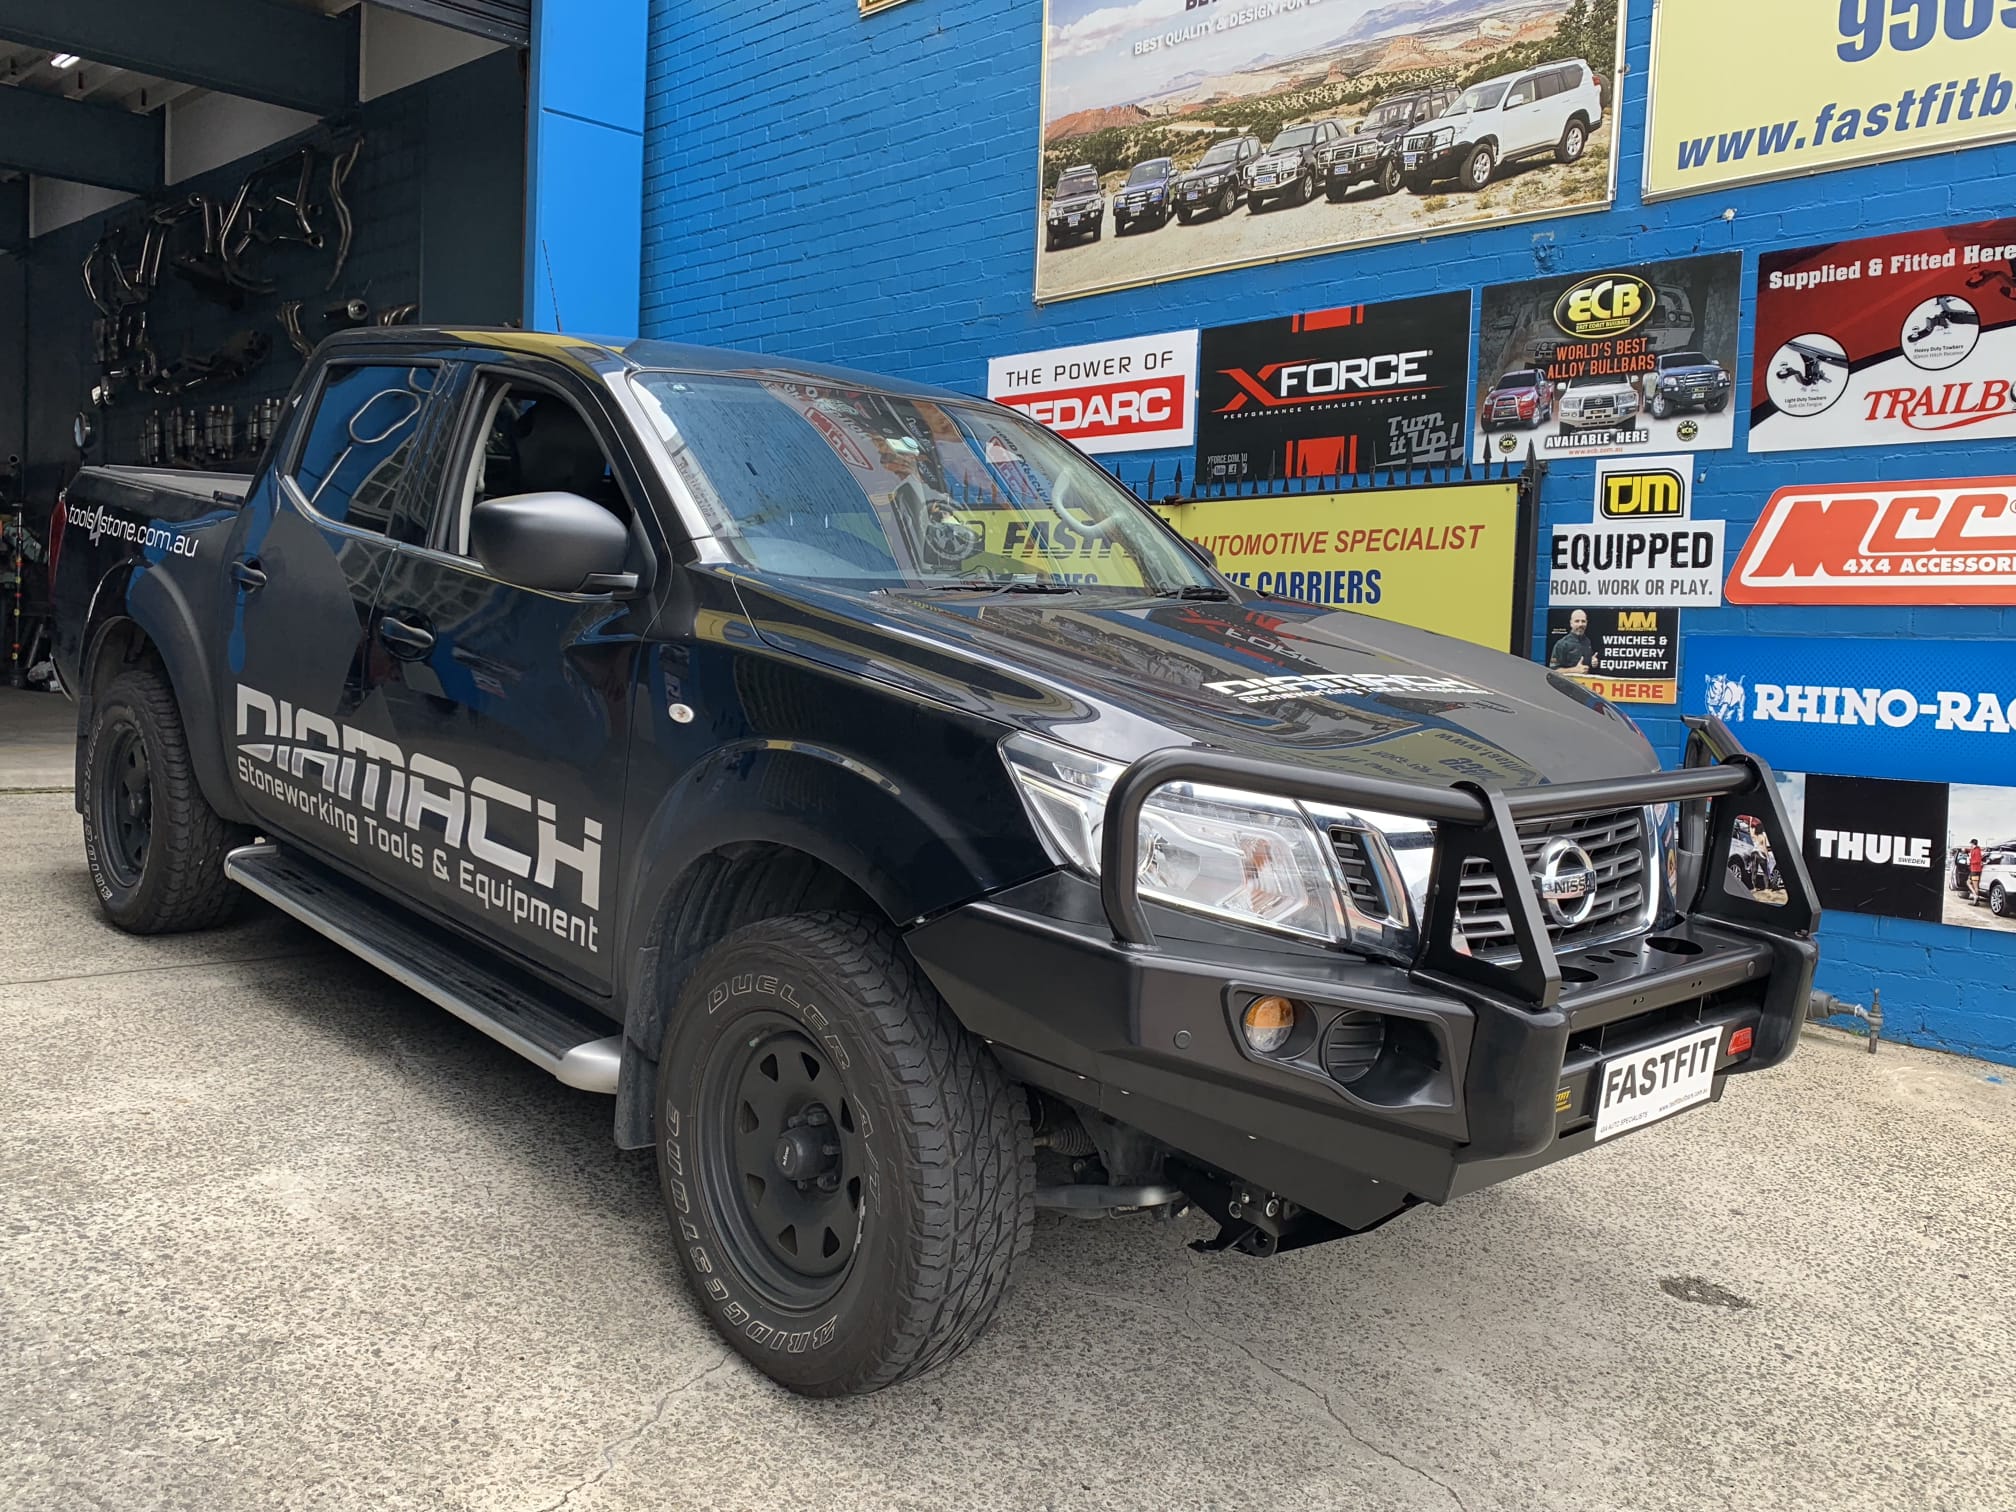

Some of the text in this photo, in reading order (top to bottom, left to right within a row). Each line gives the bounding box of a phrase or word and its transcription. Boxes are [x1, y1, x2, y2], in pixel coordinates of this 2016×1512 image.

[1134, 36, 1164, 56] BEST
[1165, 18, 1215, 46] QUALITY
[1216, 15, 1230, 31] &
[1230, 5, 1277, 28] DESIGN
[1678, 73, 2016, 170] www.fastfitb
[1769, 260, 1861, 290] Supplied
[1867, 256, 1883, 278] &
[1890, 247, 1956, 275] Fitted
[1567, 280, 1642, 322] ECB
[1547, 353, 1656, 379] ALLOY BULLBARS
[1556, 337, 1648, 361] WORLD'S BEST
[1006, 350, 1174, 388] THE POWER OF
[1211, 350, 1430, 408] XFORCE
[1223, 394, 1428, 420] PERFORMANCE EXHAUST SYSTEMS
[1388, 412, 1445, 436] Turn
[1389, 422, 1459, 456] it Up!
[1545, 429, 1649, 449] AVAILABLE HERE
[1607, 473, 1680, 513] TJM
[68, 504, 199, 558] tools4stone.com.au
[1335, 525, 1485, 553] SPECIALIST
[1552, 531, 1714, 572] EQUIPPED
[1843, 558, 1892, 574] 4X4
[1257, 570, 1382, 604] CARRIERS
[1550, 578, 1714, 596] ROAD. WORK OR PLAY.
[1618, 611, 1657, 628] MM
[1602, 635, 1668, 646] WINCHES &
[1604, 648, 1665, 658] RECOVERY
[1600, 660, 1668, 671] EQUIPMENT
[1611, 683, 1664, 699] HERE
[1753, 683, 2016, 734] RHINO-RA
[236, 683, 603, 911] DIAMACH
[237, 755, 599, 953] Stoneworking Tools & Equipment
[1815, 829, 1932, 868] THULE
[1898, 857, 1927, 865] SWEDEN
[707, 972, 851, 1070] DUELER
[1604, 1037, 1717, 1109] FASTFIT
